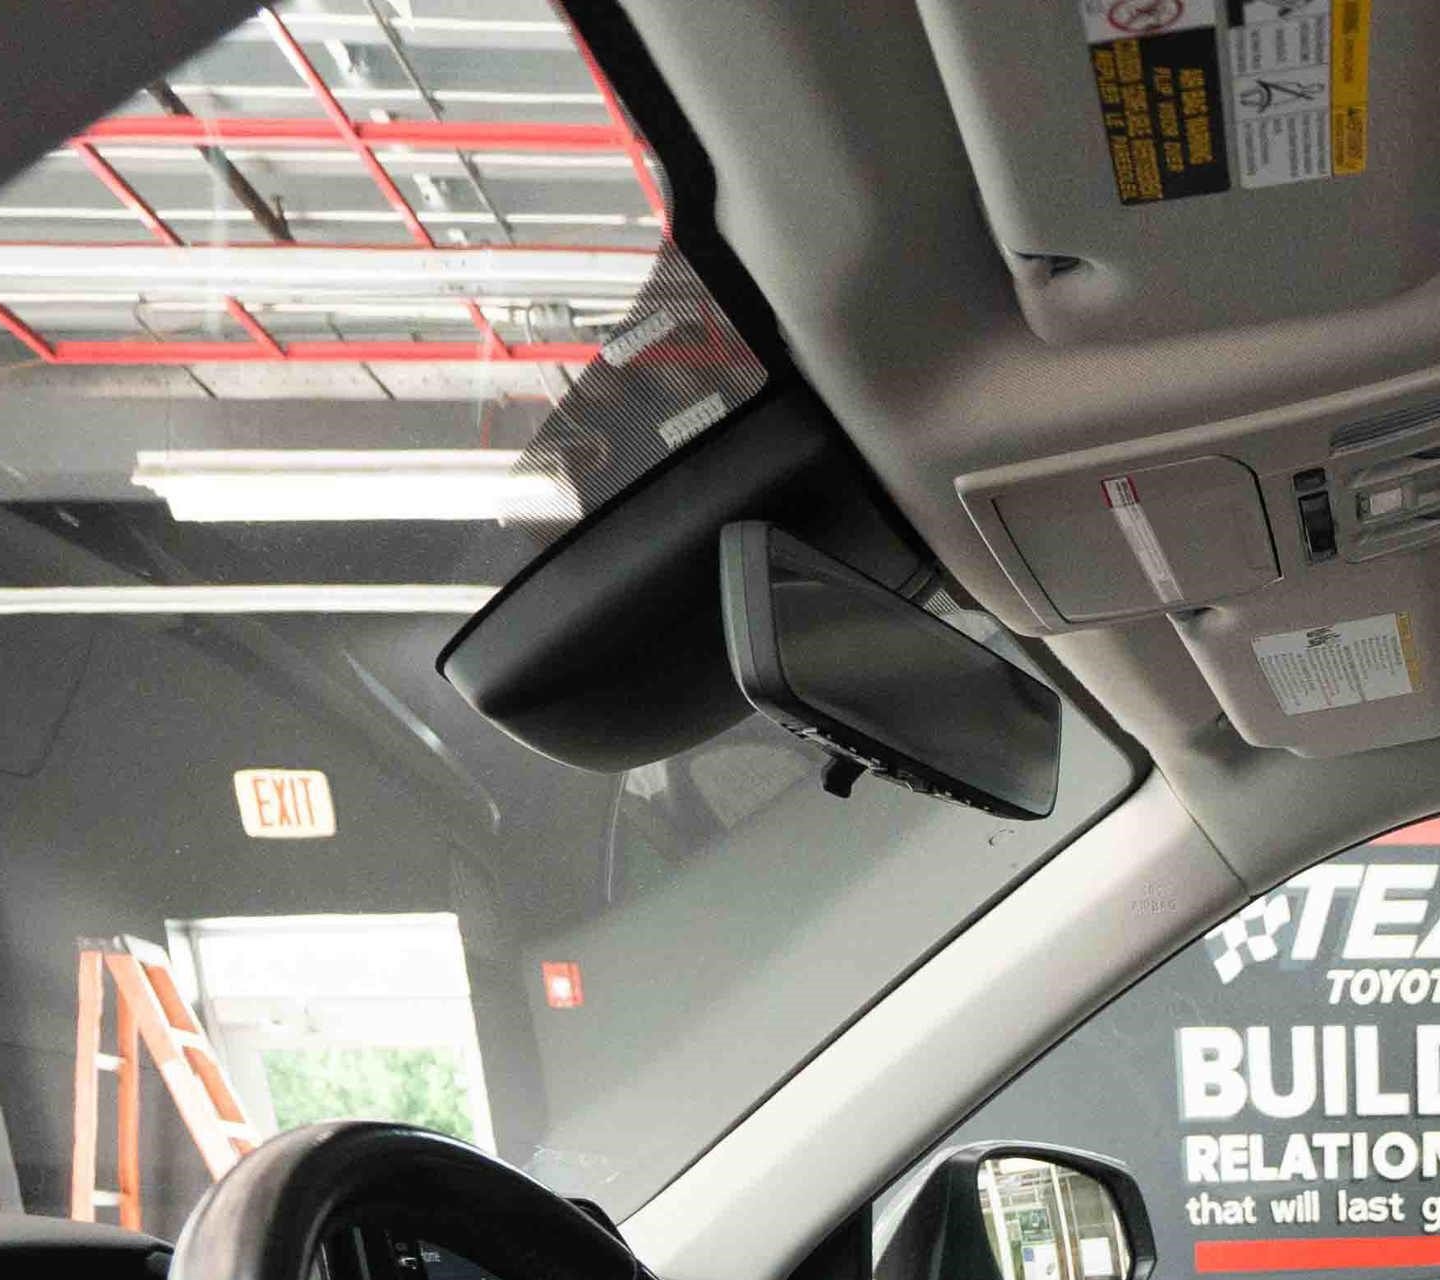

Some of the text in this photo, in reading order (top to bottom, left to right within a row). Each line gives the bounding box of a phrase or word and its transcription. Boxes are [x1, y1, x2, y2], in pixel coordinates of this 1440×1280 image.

[252, 776, 314, 827] EXIT
[1186, 1192, 1257, 1226] that
[1271, 1190, 1320, 1222] will
[1338, 1188, 1405, 1222] last
